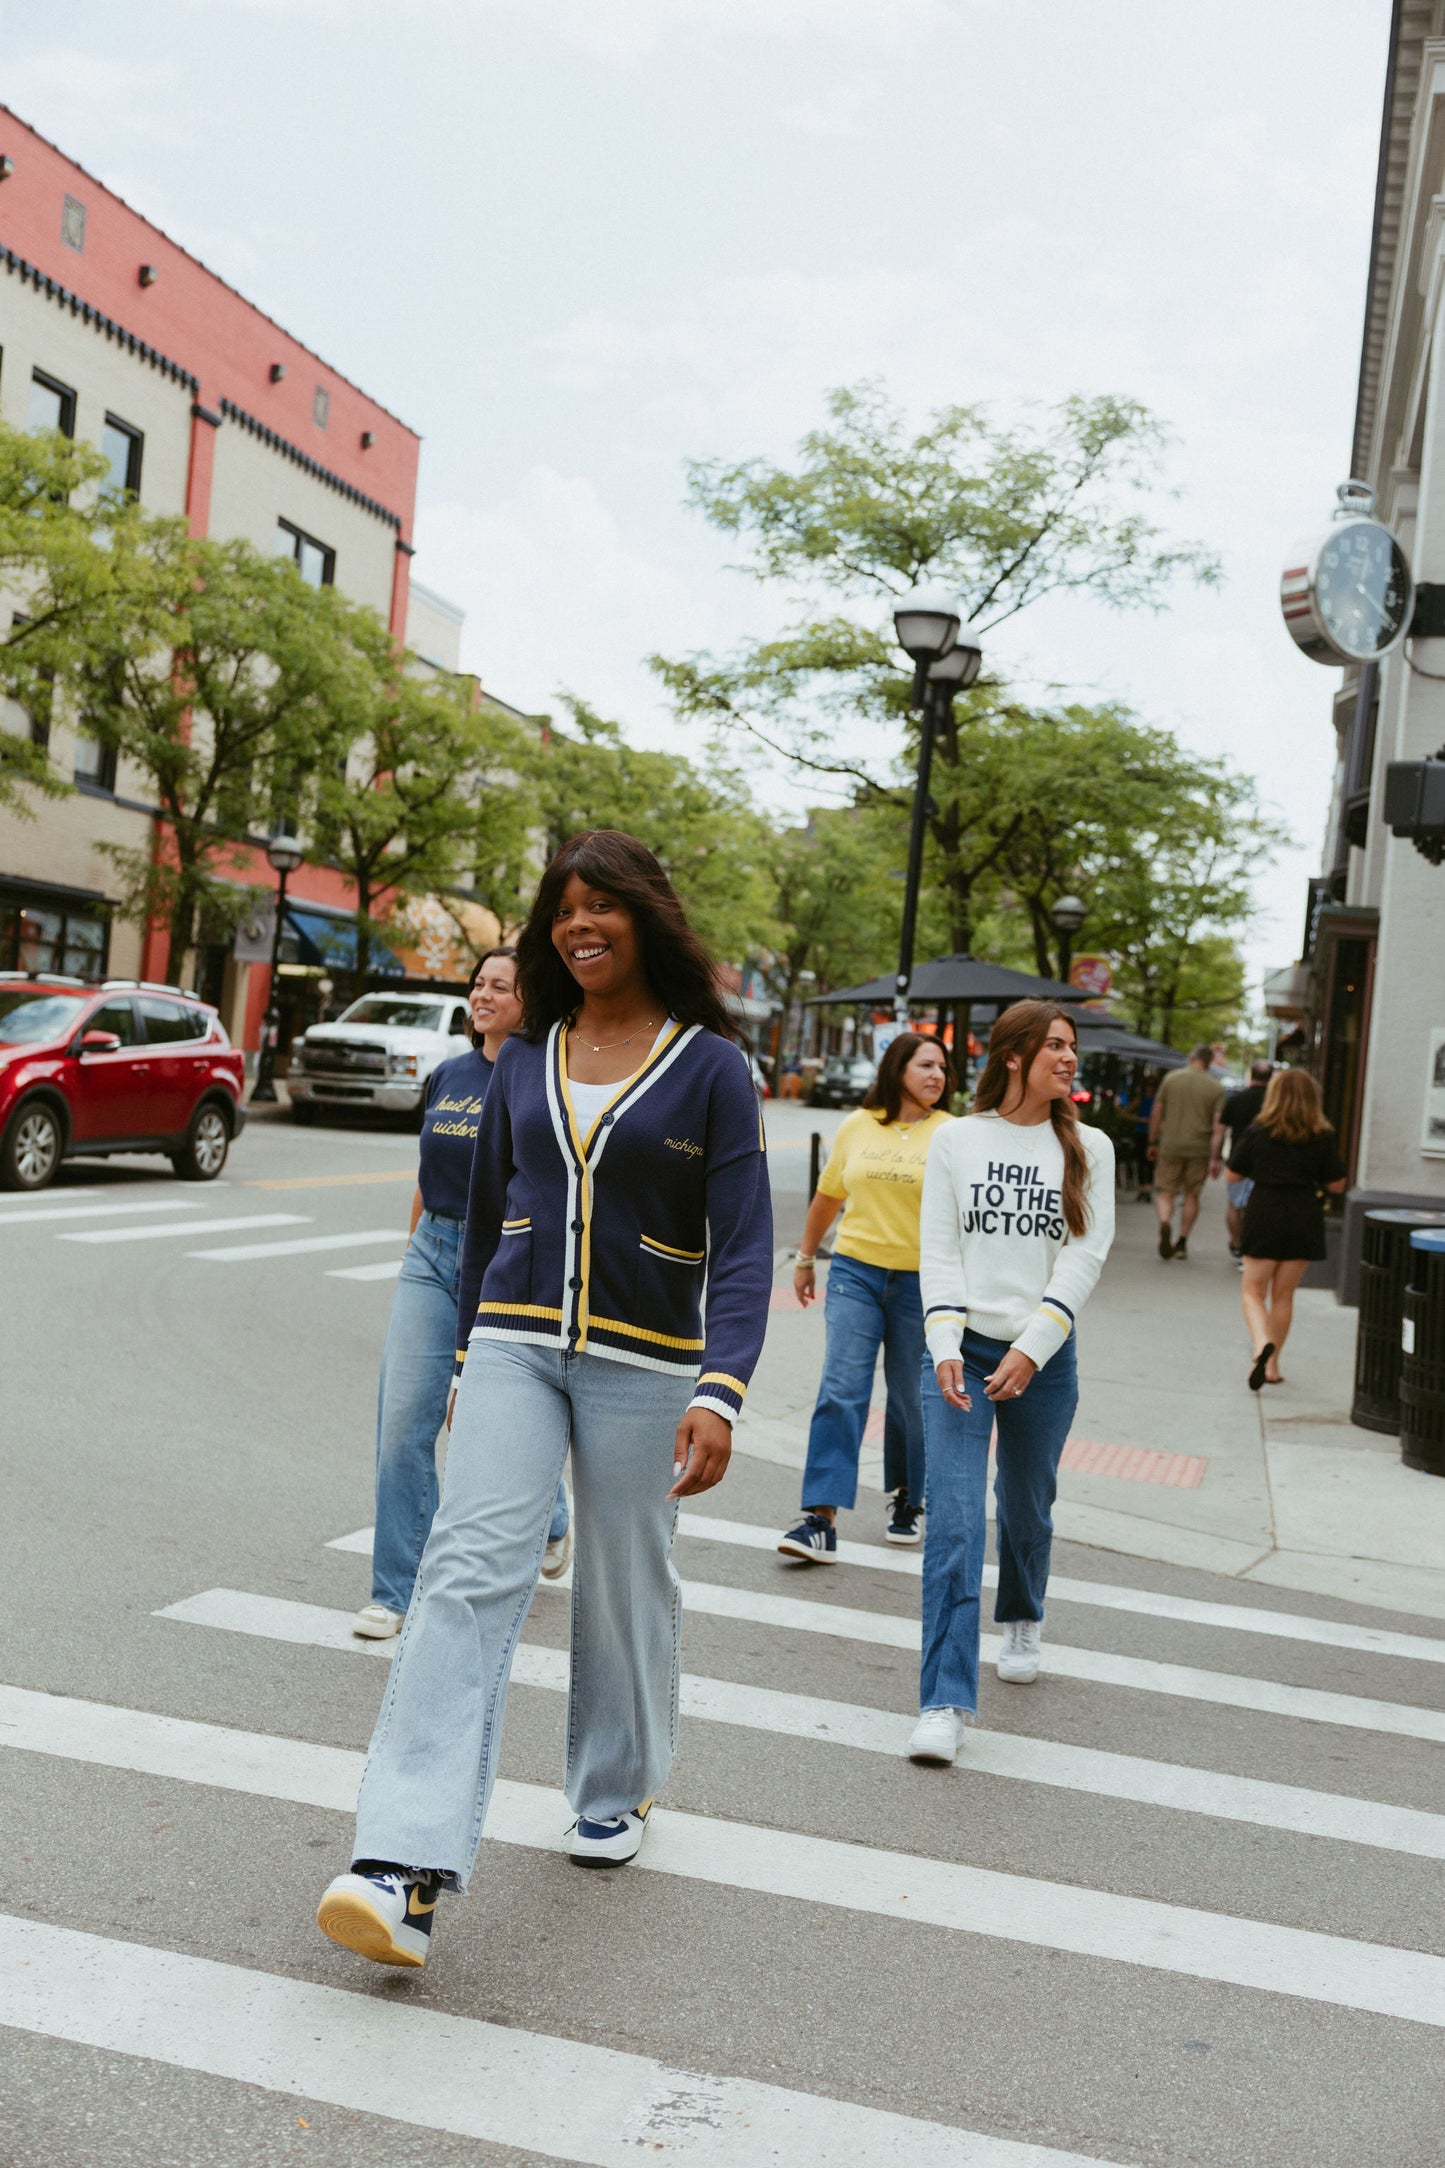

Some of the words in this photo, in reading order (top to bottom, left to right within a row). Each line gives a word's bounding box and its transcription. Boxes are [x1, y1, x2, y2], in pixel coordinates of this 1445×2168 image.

[435, 1094, 472, 1112] hail
[466, 1097, 482, 1114] to
[432, 1117, 478, 1138] victor
[663, 1138, 704, 1160] michiga
[860, 1144, 891, 1161] hail
[890, 1149, 904, 1163] to
[988, 1161, 1044, 1186] HAIL
[970, 1183, 1004, 1208] TO
[1013, 1188, 1062, 1214] THE
[962, 1210, 1065, 1241] VICTORS
